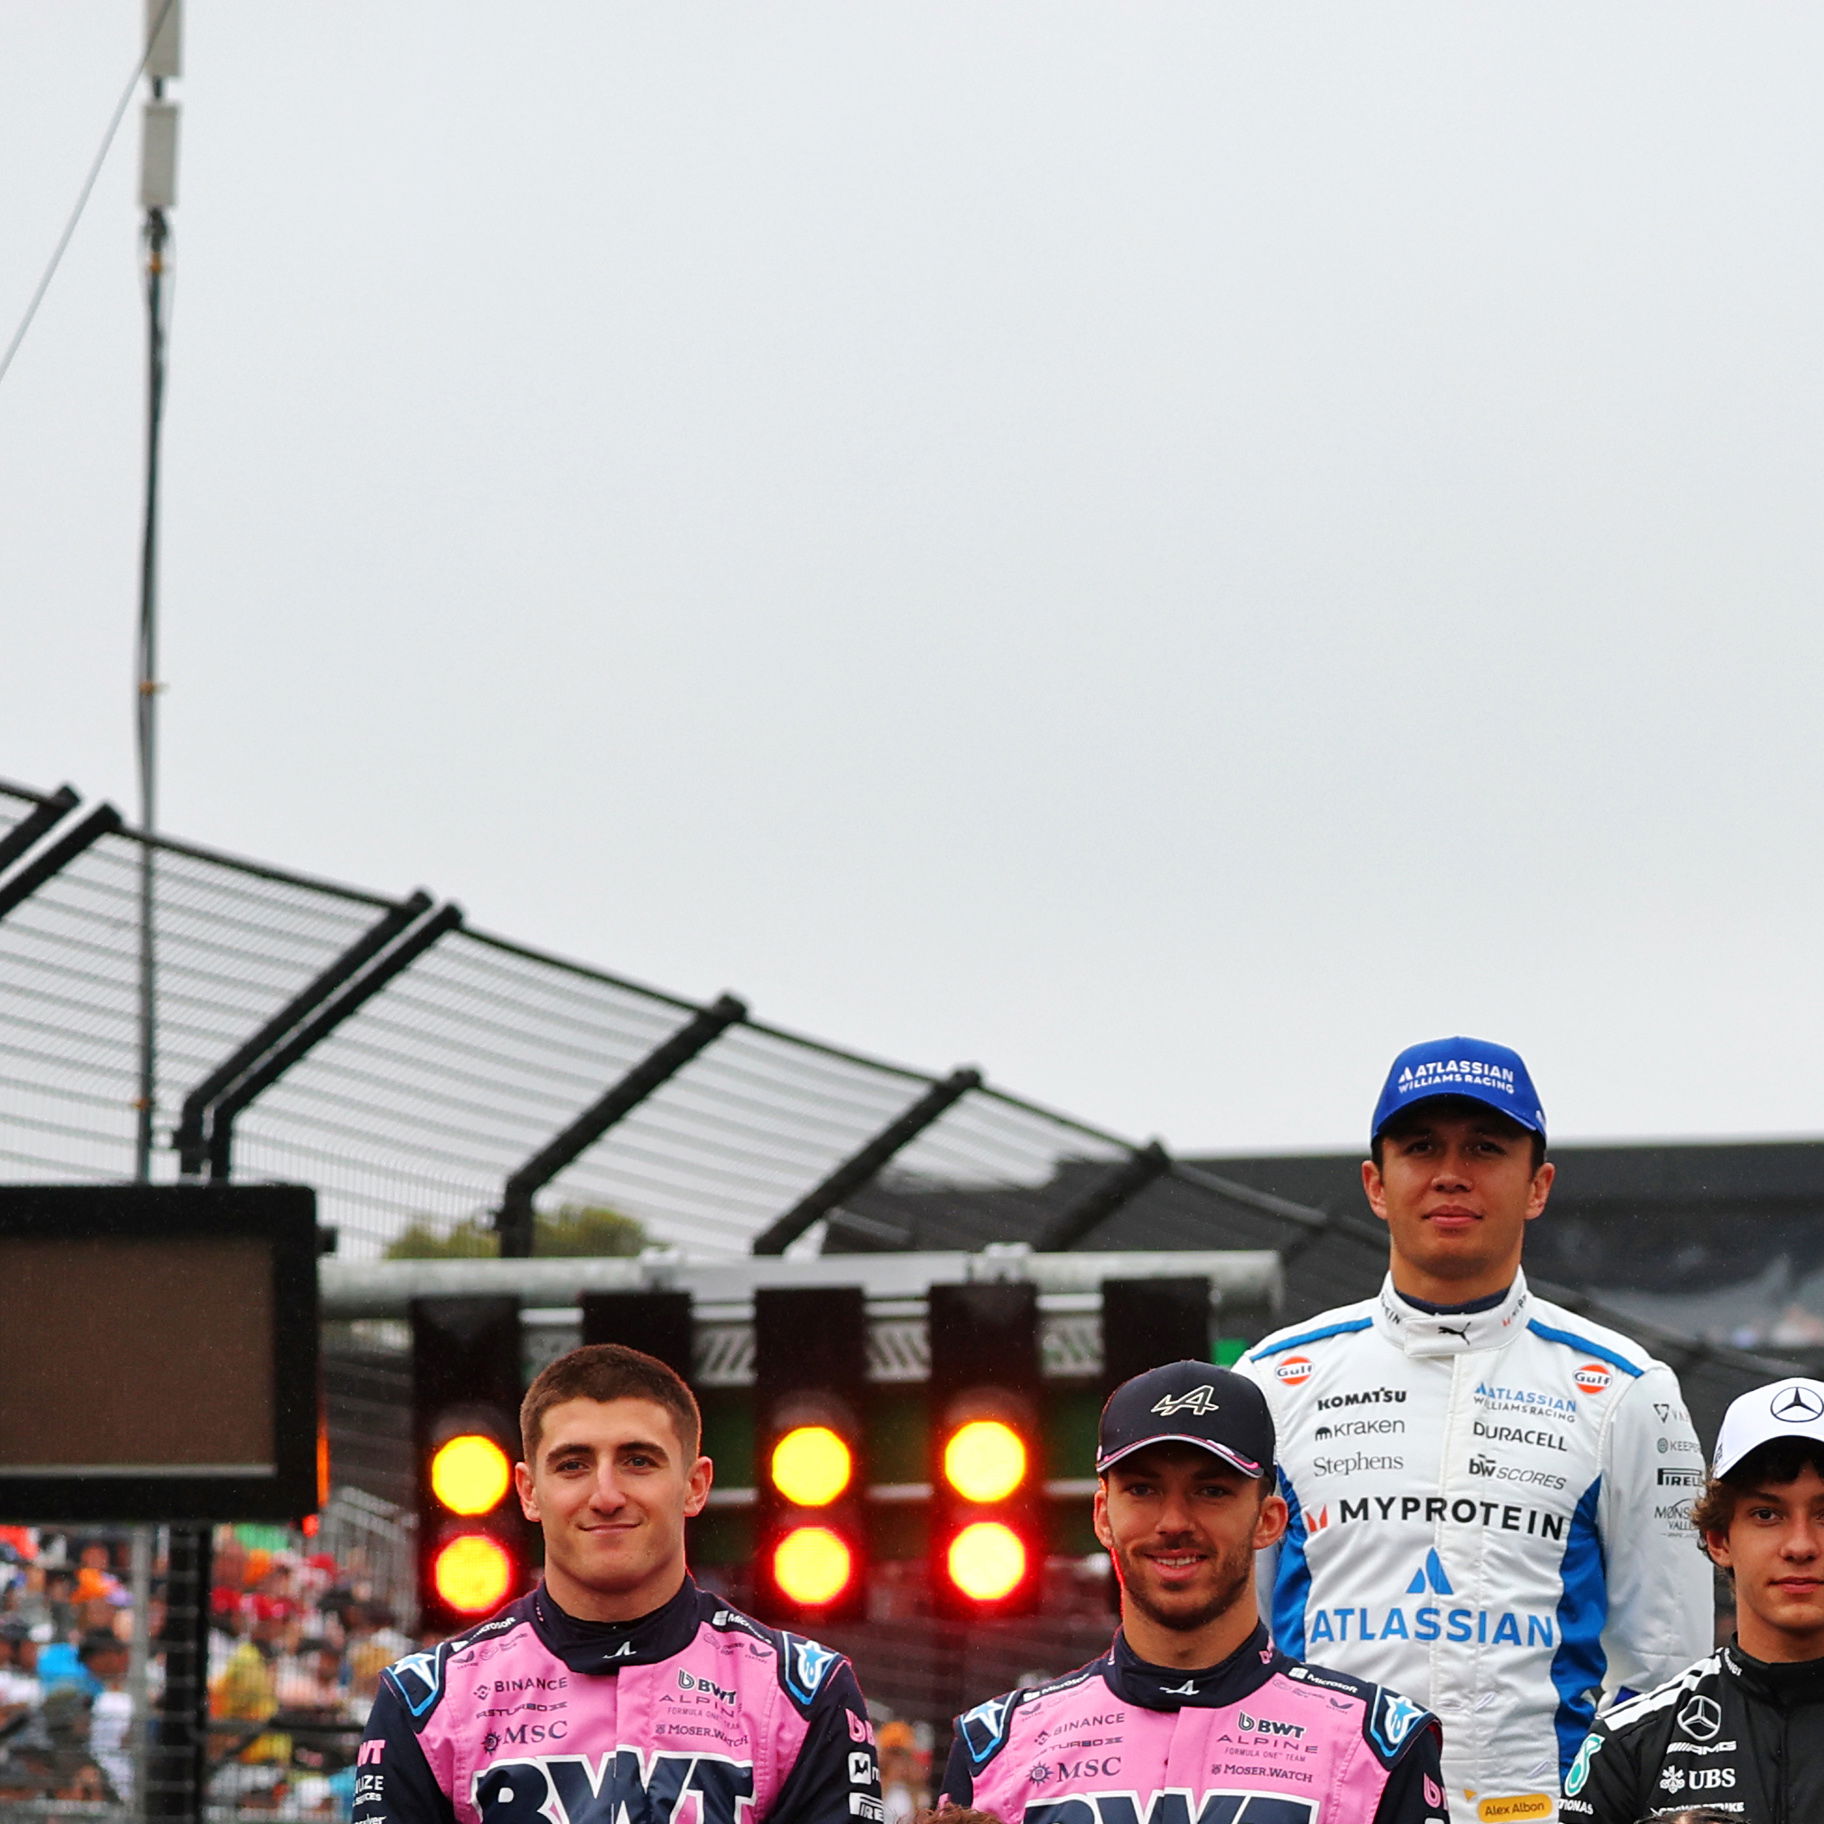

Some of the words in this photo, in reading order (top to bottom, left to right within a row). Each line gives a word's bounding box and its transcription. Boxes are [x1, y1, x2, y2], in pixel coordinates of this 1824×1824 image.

[1414, 1059, 1515, 1082] ATLASSIAN
[1399, 1073, 1462, 1094] WILLIAMS
[1464, 1074, 1515, 1094] RACING
[1317, 1386, 1407, 1411] KOMATSU
[1528, 1405, 1576, 1423] RACING
[1473, 1421, 1568, 1451] DURACELL
[1313, 1455, 1404, 1477] Stephens
[1339, 1497, 1564, 1541] MYPROTEIN
[1309, 1606, 1554, 1648] ATLASSIAN
[494, 1676, 568, 1693] BINANCE
[502, 1720, 568, 1744] MSC
[1053, 1712, 1125, 1738] BINANCE
[1257, 1719, 1305, 1739] BWT
[1217, 1735, 1318, 1753] ALPINE
[1055, 1757, 1121, 1783] MSC
[1224, 1764, 1313, 1782] MOSER.WATCH
[1688, 1768, 1736, 1790] UBS
[1485, 1806, 1509, 1815] Alex
[1512, 1802, 1544, 1813] Albon
